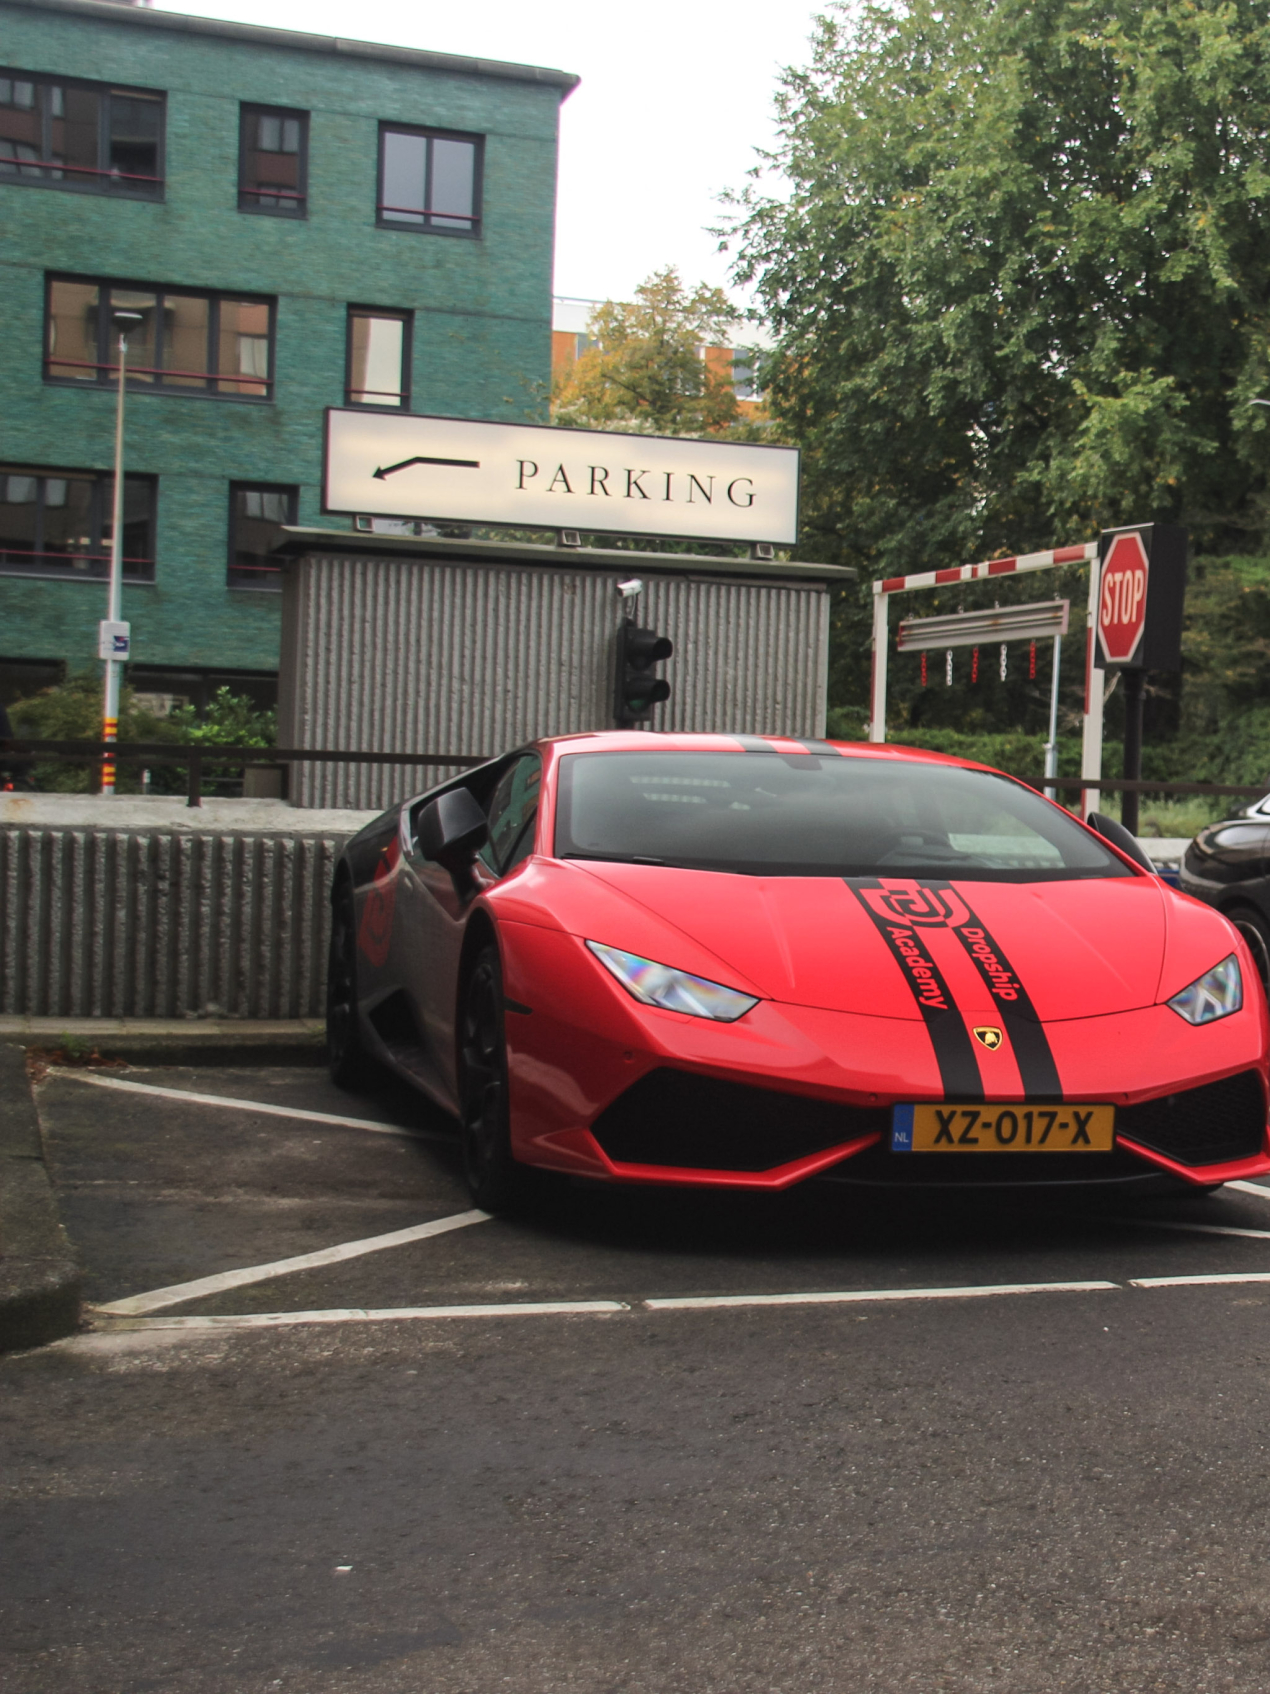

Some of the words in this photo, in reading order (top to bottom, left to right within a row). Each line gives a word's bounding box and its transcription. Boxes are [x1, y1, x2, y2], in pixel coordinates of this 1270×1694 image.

[514, 459, 757, 508] PARKING
[1102, 569, 1144, 627] STOP
[886, 926, 949, 1010] Academy
[960, 927, 1021, 1001] Dropship
[894, 1132, 909, 1143] NL
[933, 1109, 1094, 1146] XZ-017-X
